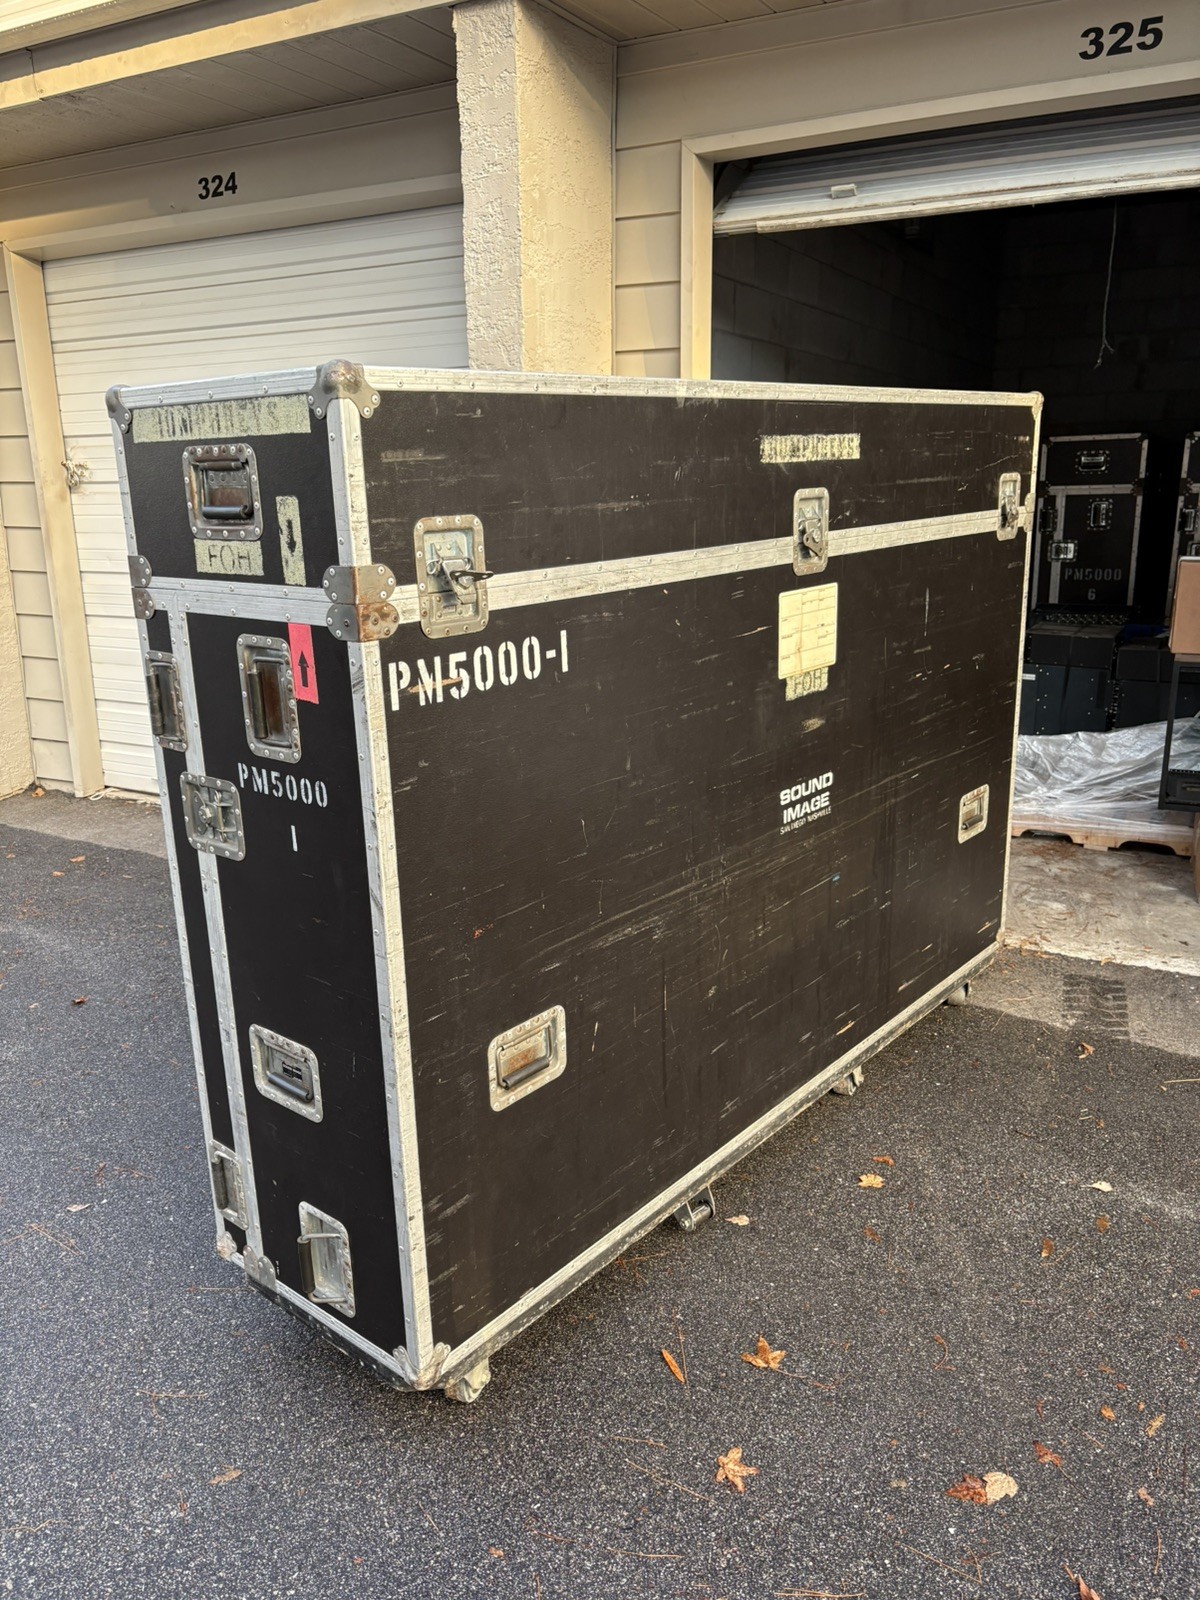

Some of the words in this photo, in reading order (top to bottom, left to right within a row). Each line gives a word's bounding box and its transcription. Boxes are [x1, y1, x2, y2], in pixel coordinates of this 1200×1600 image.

[1078, 15, 1164, 60] 325
[197, 171, 238, 200] 324
[207, 544, 252, 573] FOH
[1064, 568, 1123, 581] PM5000
[1087, 588, 1097, 601] 6
[237, 762, 328, 808] PM5000
[779, 771, 834, 806] SOUND
[783, 791, 830, 825] IMAGE
